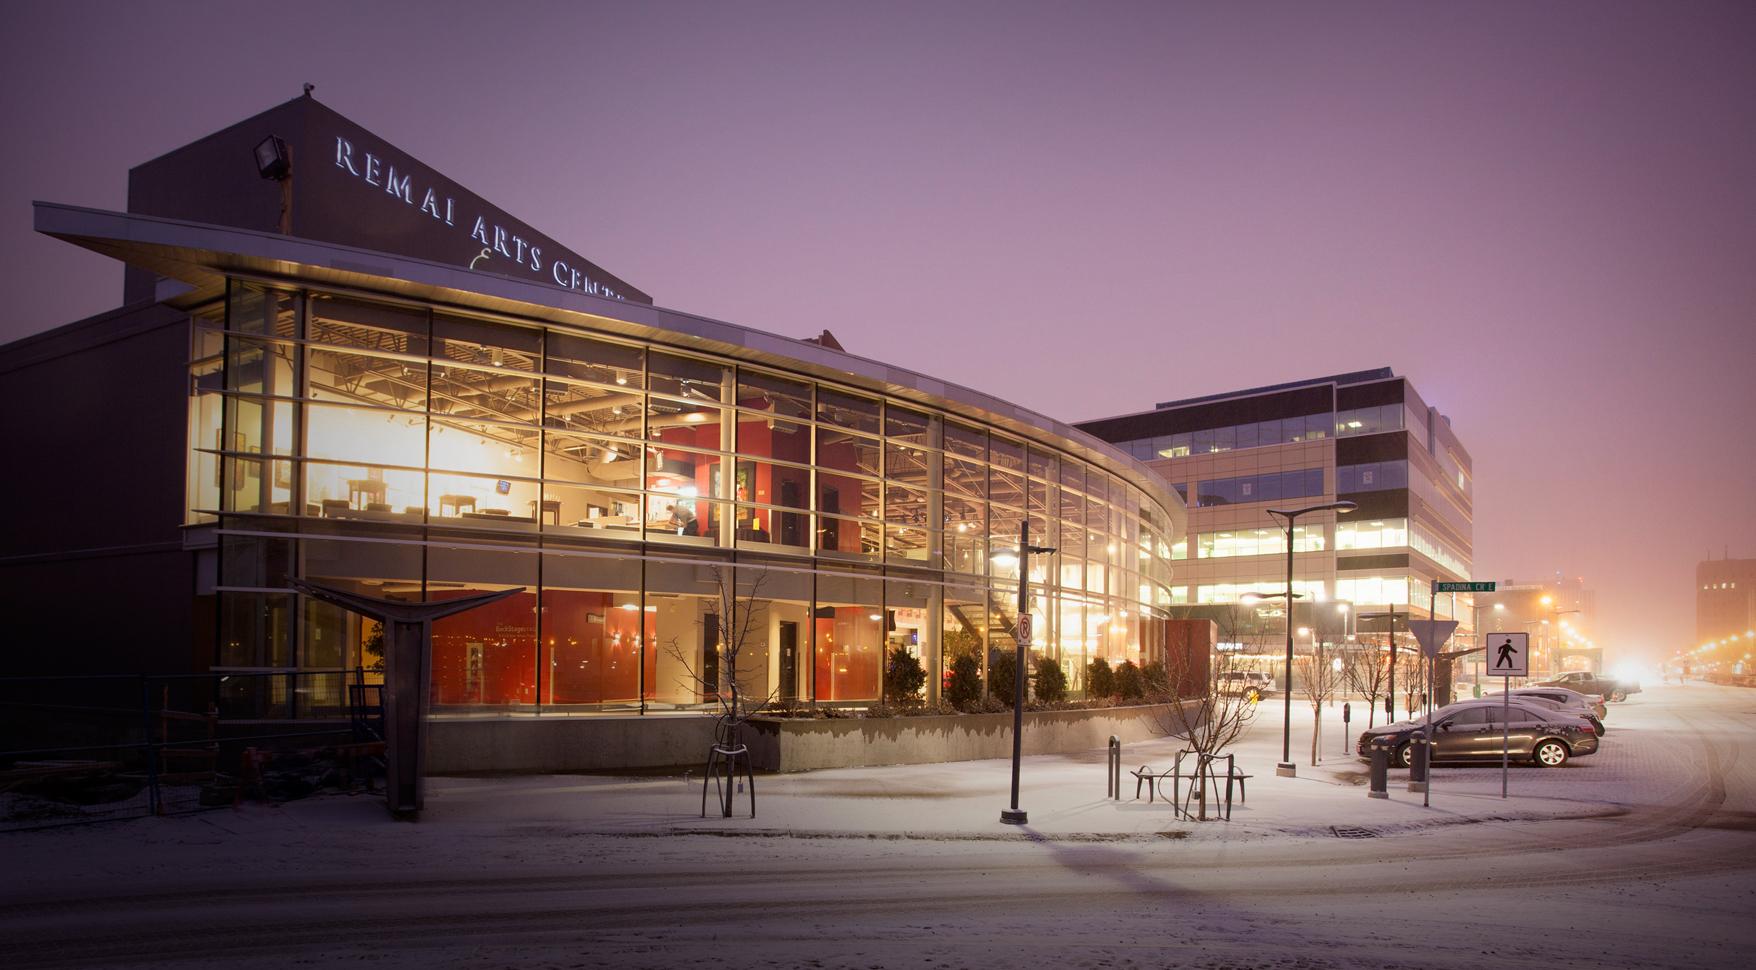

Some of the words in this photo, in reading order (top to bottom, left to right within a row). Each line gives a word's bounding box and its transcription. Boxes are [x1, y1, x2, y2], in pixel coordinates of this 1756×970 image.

[335, 135, 456, 227] REMAI
[470, 215, 542, 272] ARTS
[1442, 583, 1472, 591] SPADINA
[1488, 583, 1493, 591] E
